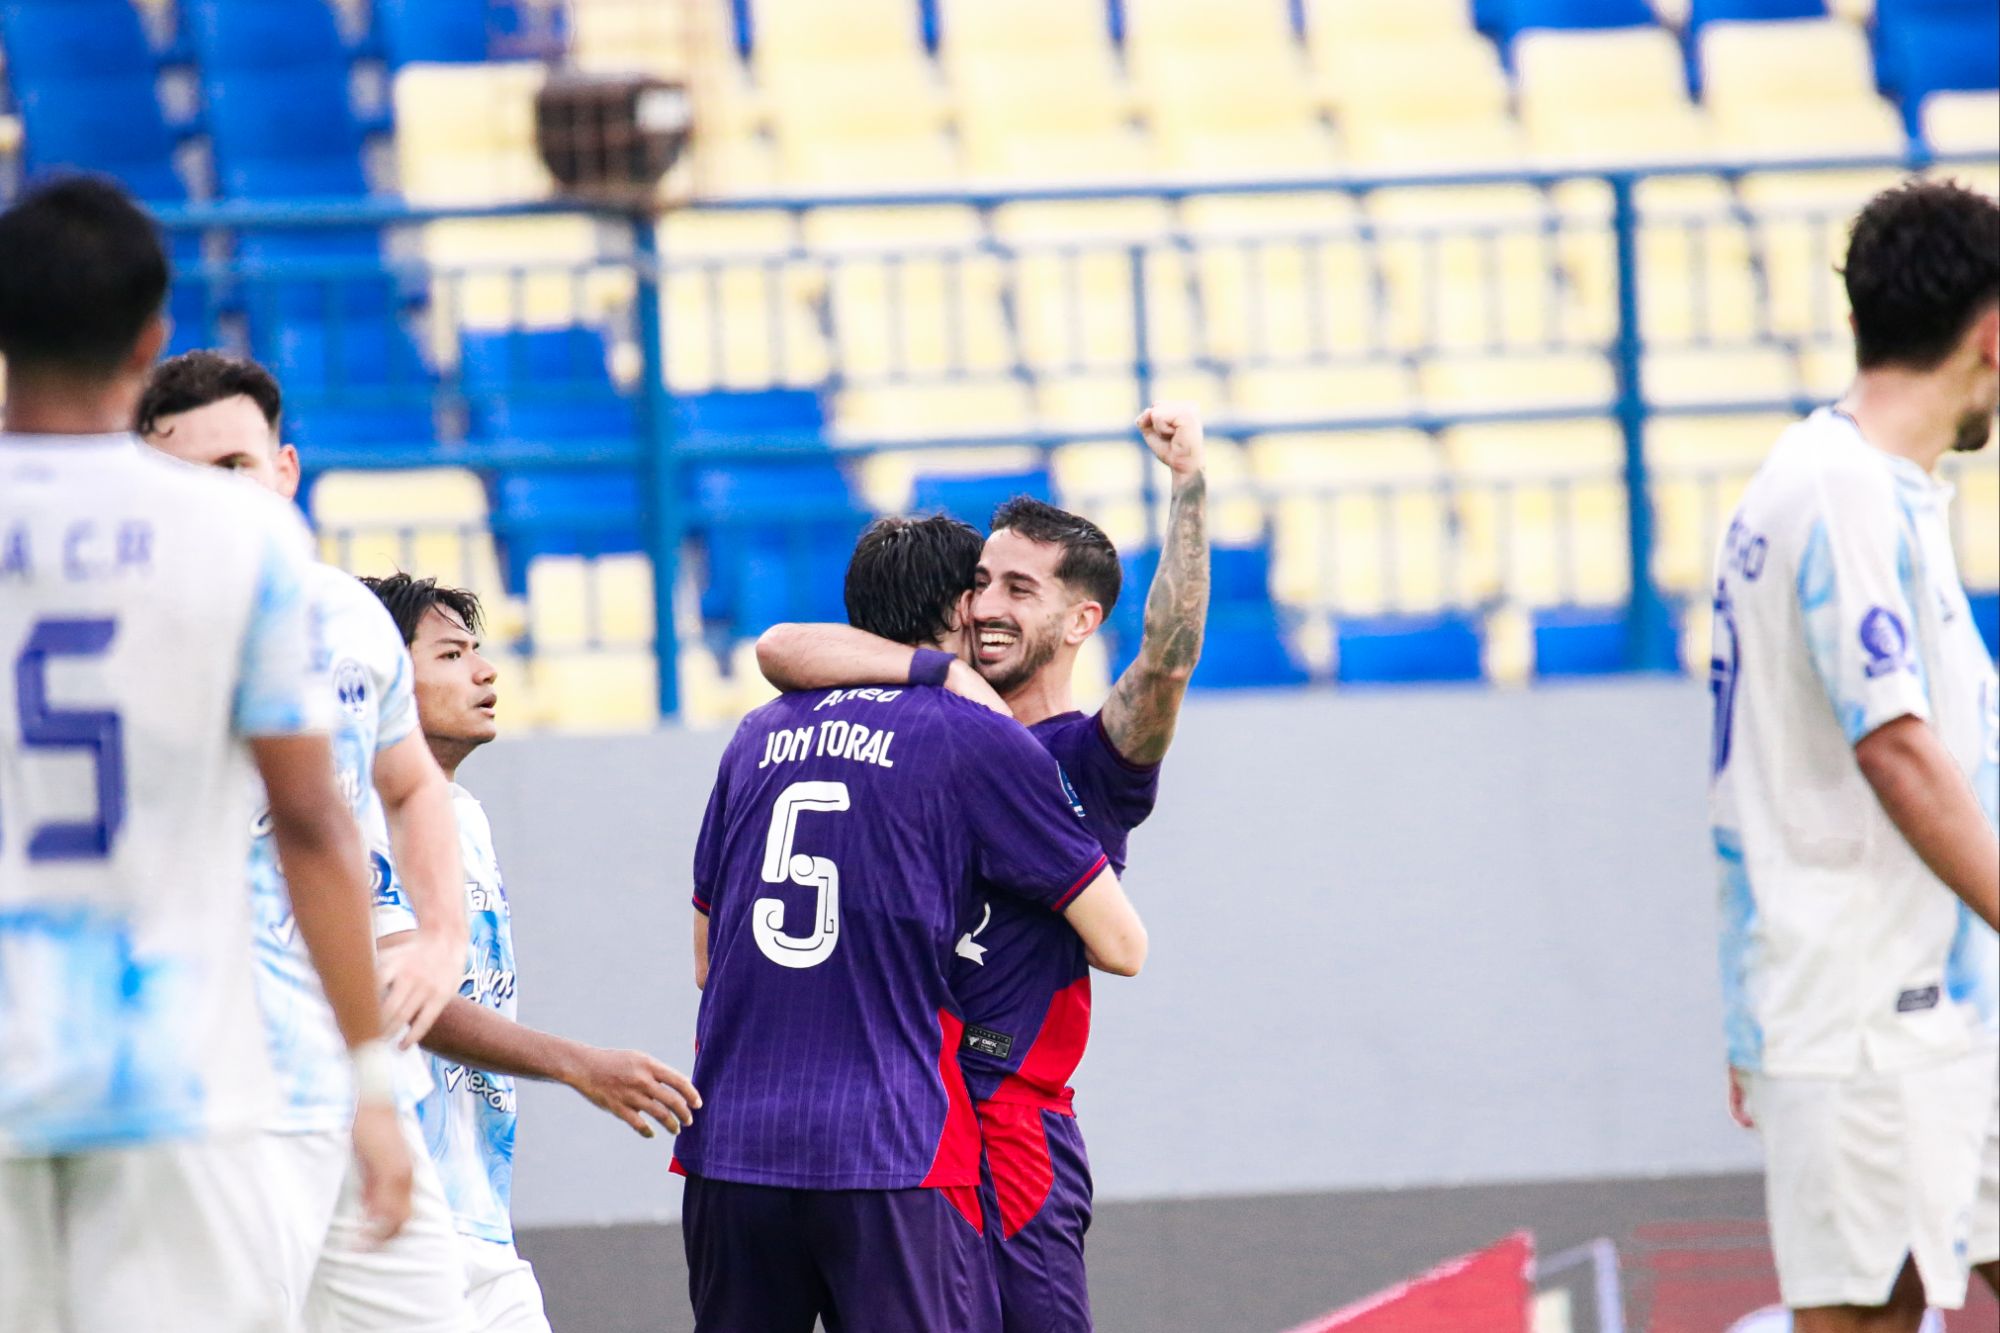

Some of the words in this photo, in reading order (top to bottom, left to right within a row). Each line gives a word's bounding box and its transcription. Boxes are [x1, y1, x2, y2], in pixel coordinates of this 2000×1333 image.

[758, 725, 815, 769] JON
[815, 720, 895, 769] TORAL
[751, 780, 850, 969] 5
